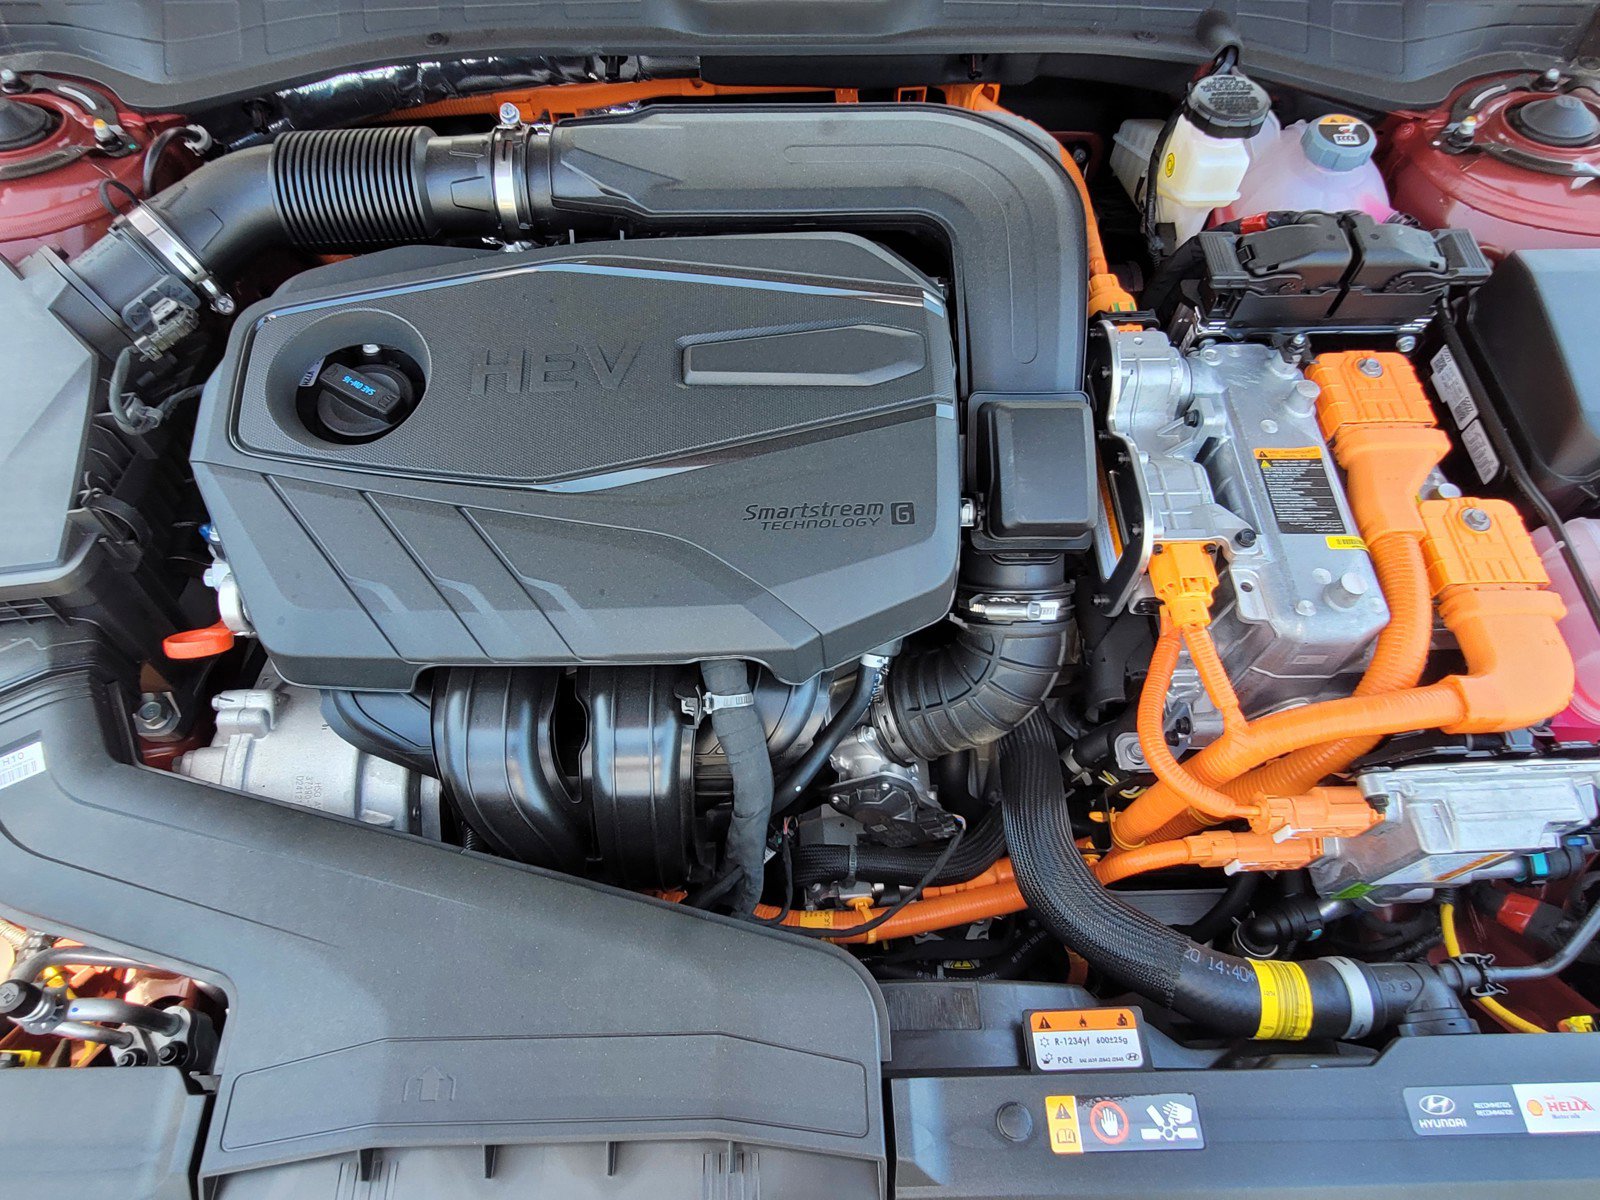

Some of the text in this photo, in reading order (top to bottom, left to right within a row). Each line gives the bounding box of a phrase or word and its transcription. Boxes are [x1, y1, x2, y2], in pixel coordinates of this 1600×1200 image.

[470, 344, 643, 396] HEV
[360, 385, 376, 396] SAE
[742, 501, 885, 521] Smartstream
[760, 517, 881, 531] TECHNOLOGY
[1054, 1036, 1090, 1046] R-1234yf
[1057, 1056, 1073, 1064] POE
[1545, 1101, 1592, 1112] HELIX
[1418, 1118, 1468, 1129] HYUNDAI
